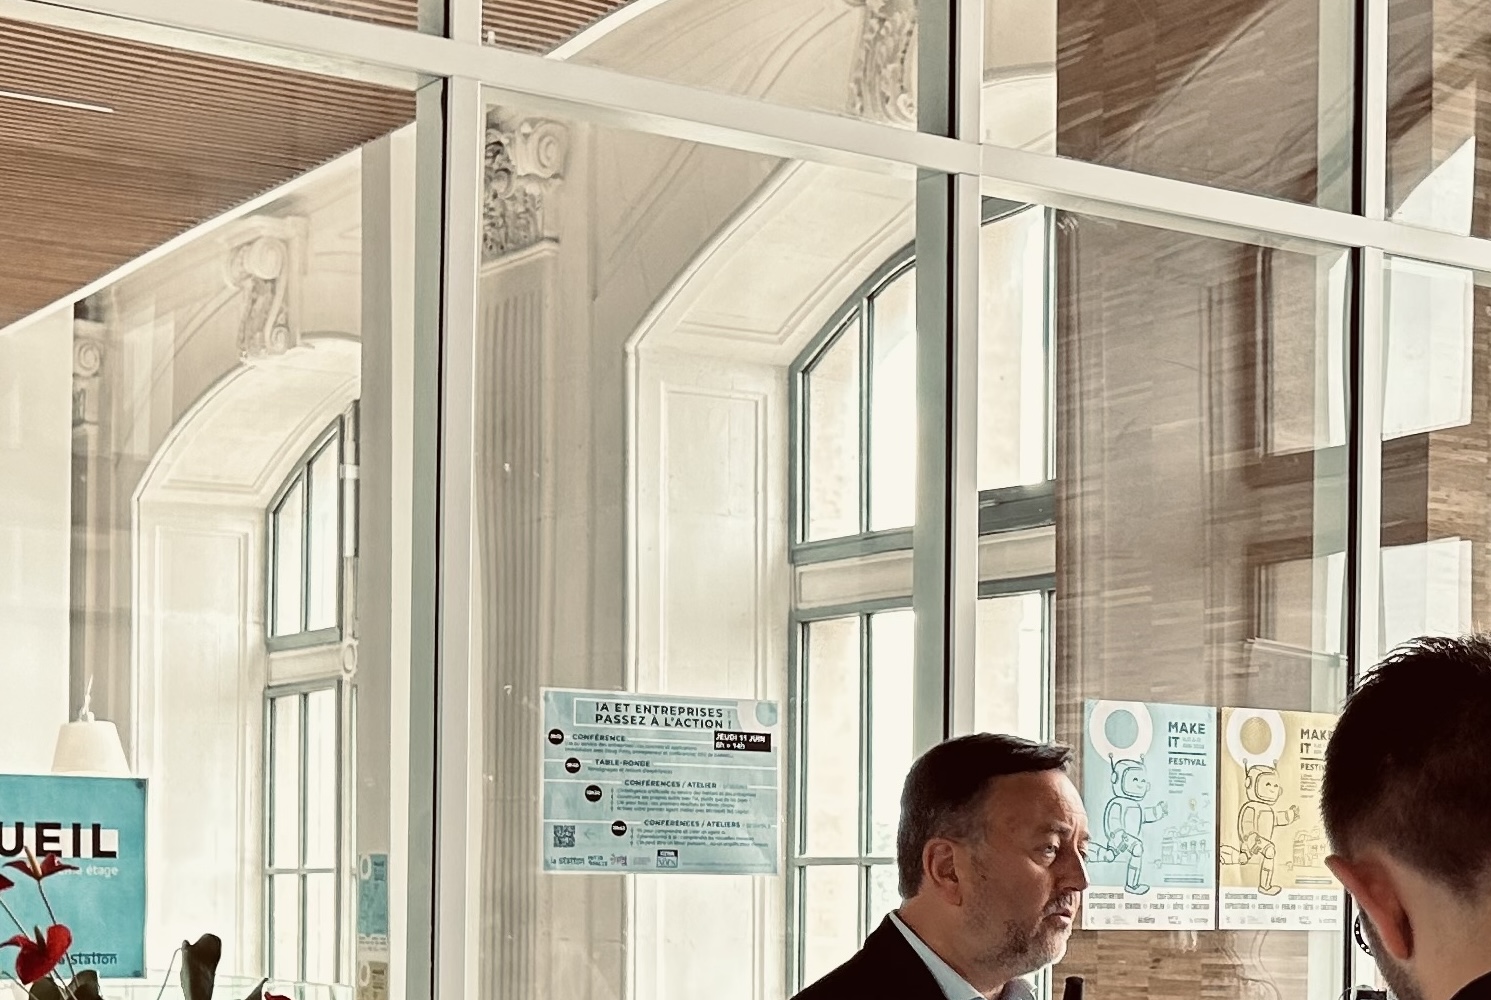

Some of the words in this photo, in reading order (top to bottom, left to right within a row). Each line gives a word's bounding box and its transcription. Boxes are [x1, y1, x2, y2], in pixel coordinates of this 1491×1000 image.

[595, 701, 609, 712] IA
[614, 702, 630, 713] ET
[635, 704, 723, 718] ENTREPRISES
[595, 713, 646, 725] PASSEZ
[650, 714, 660, 726] À
[664, 716, 723, 729] L'ACTION
[1168, 721, 1206, 735] MAKE
[1168, 735, 1180, 749] IT
[1300, 743, 1312, 754] IT
[594, 758, 651, 767] TABLE-RONDE
[1168, 756, 1207, 767] FESTIVAL
[86, 865, 119, 878] étage
